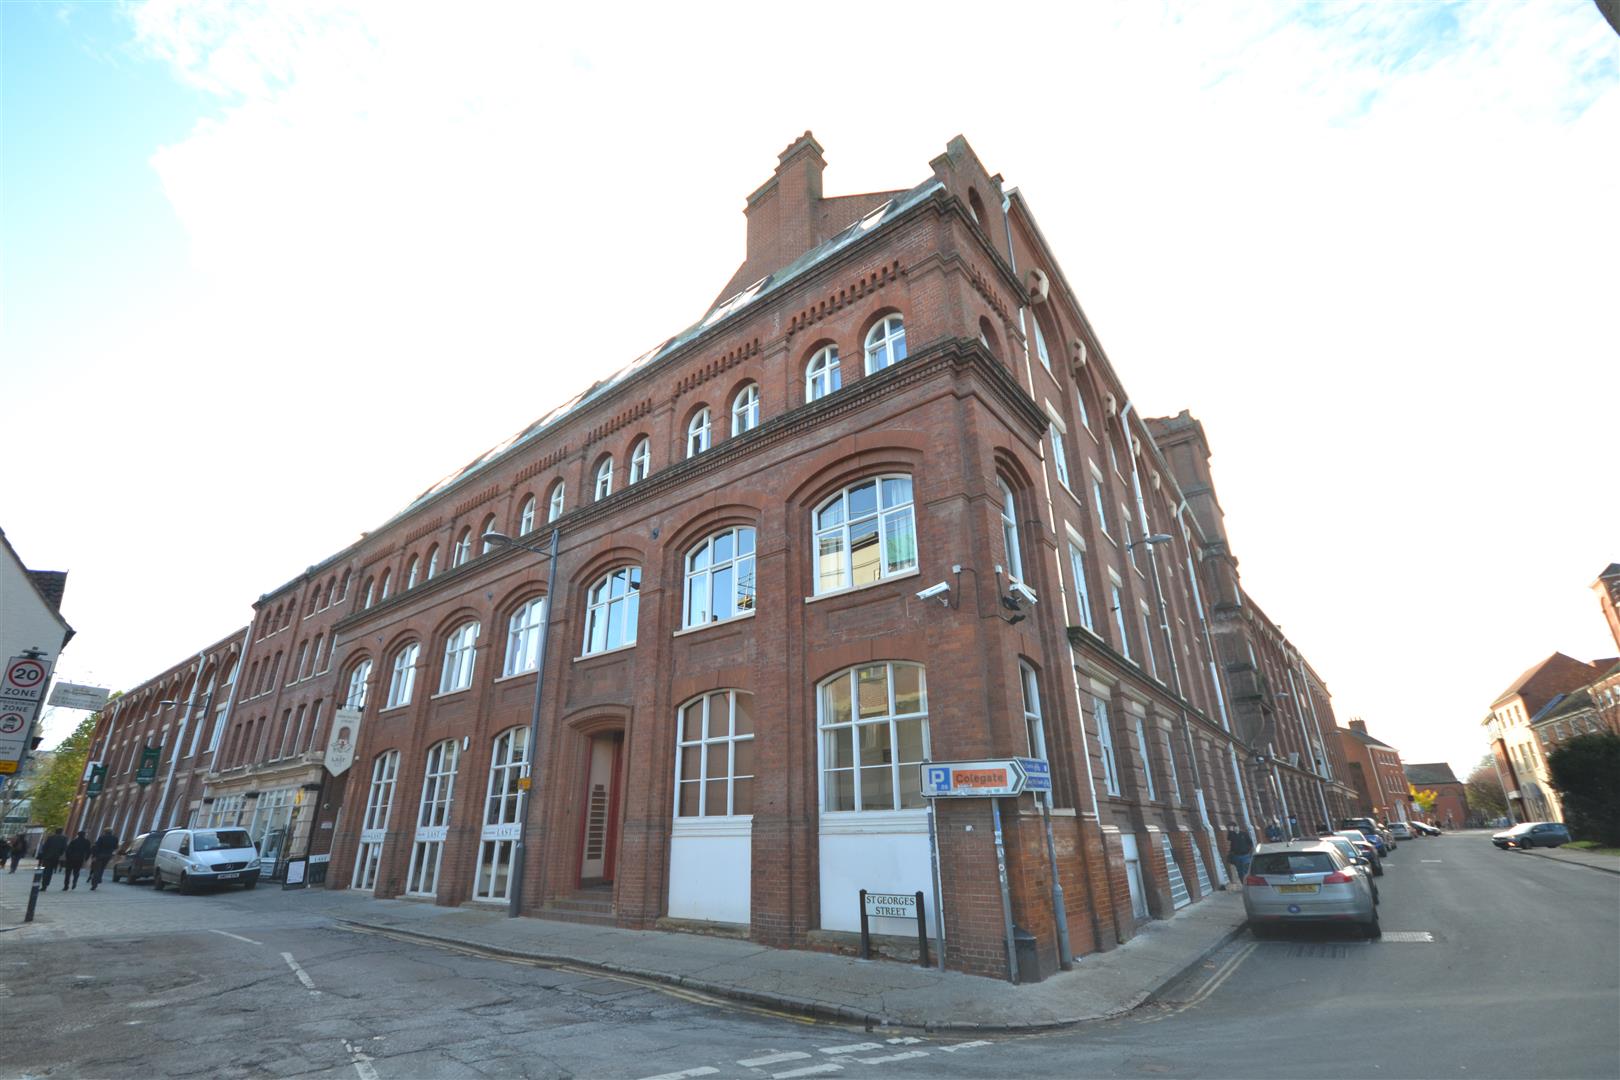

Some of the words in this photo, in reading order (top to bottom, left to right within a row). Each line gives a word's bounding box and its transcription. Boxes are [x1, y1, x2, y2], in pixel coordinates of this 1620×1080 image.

[14, 668, 39, 681] 20
[4, 687, 38, 697] ZONE
[2, 704, 29, 713] ZONE
[956, 773, 1003, 786] Colegate
[866, 896, 876, 904] ST
[877, 896, 915, 906] GEORGES
[875, 906, 906, 916] STREET
